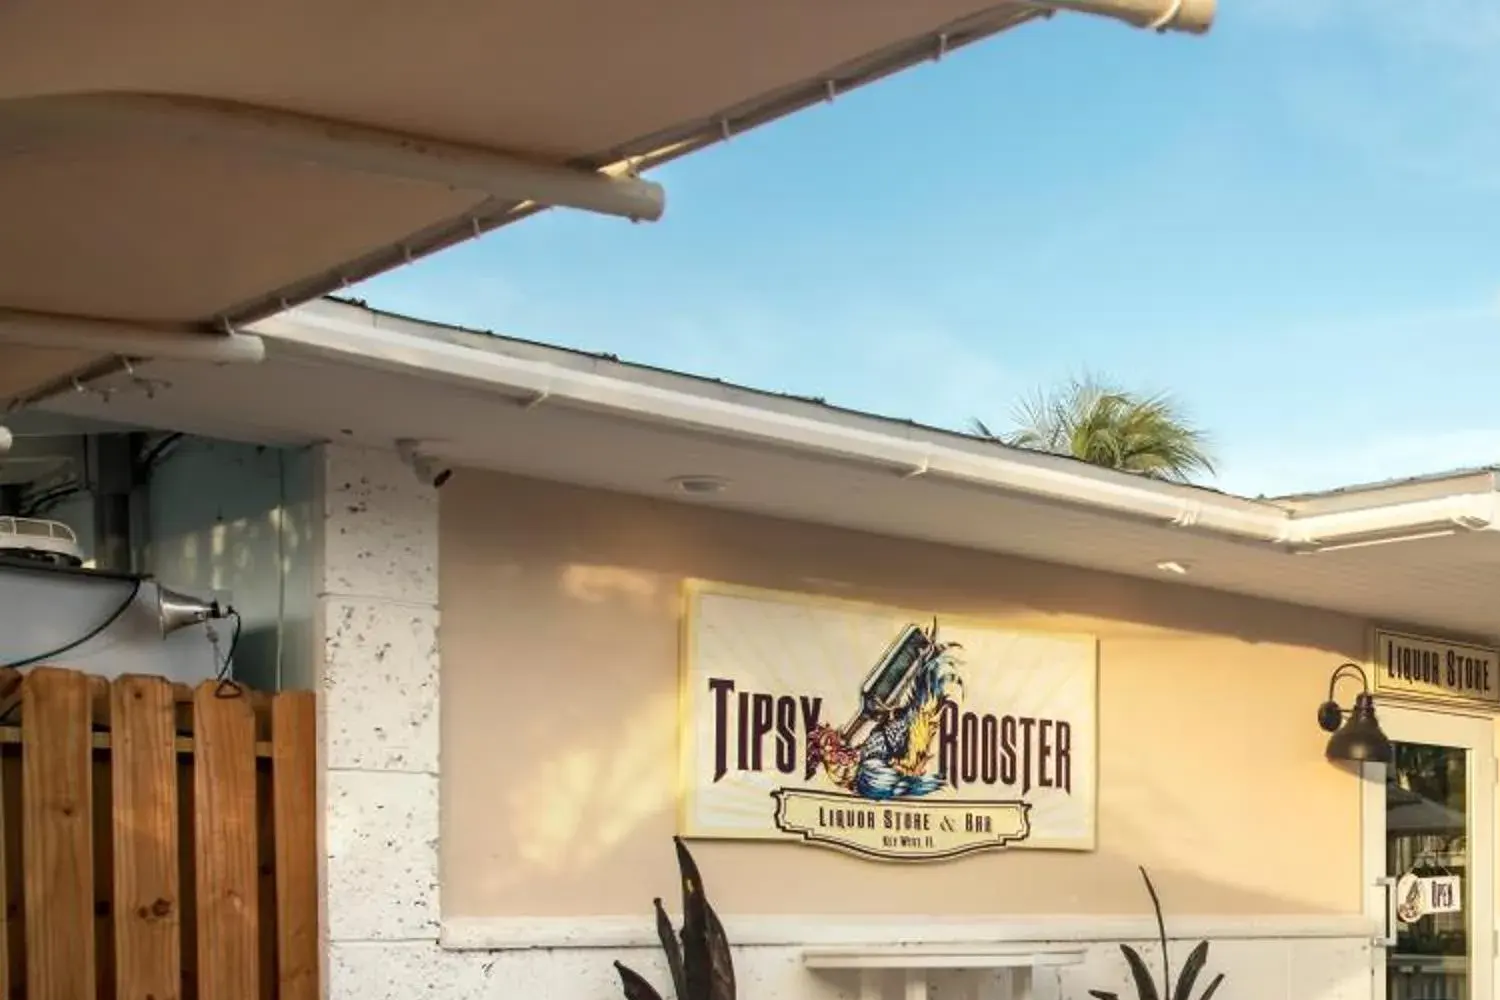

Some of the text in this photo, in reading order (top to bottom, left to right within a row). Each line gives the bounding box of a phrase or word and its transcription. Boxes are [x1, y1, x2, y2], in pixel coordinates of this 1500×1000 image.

[1388, 641, 1489, 691] LIQUOR STORE
[708, 678, 1072, 794] TIPSY ROOSTER
[819, 806, 992, 834] LIQUOR STORE & BAR
[1432, 880, 1455, 908] OPEN
